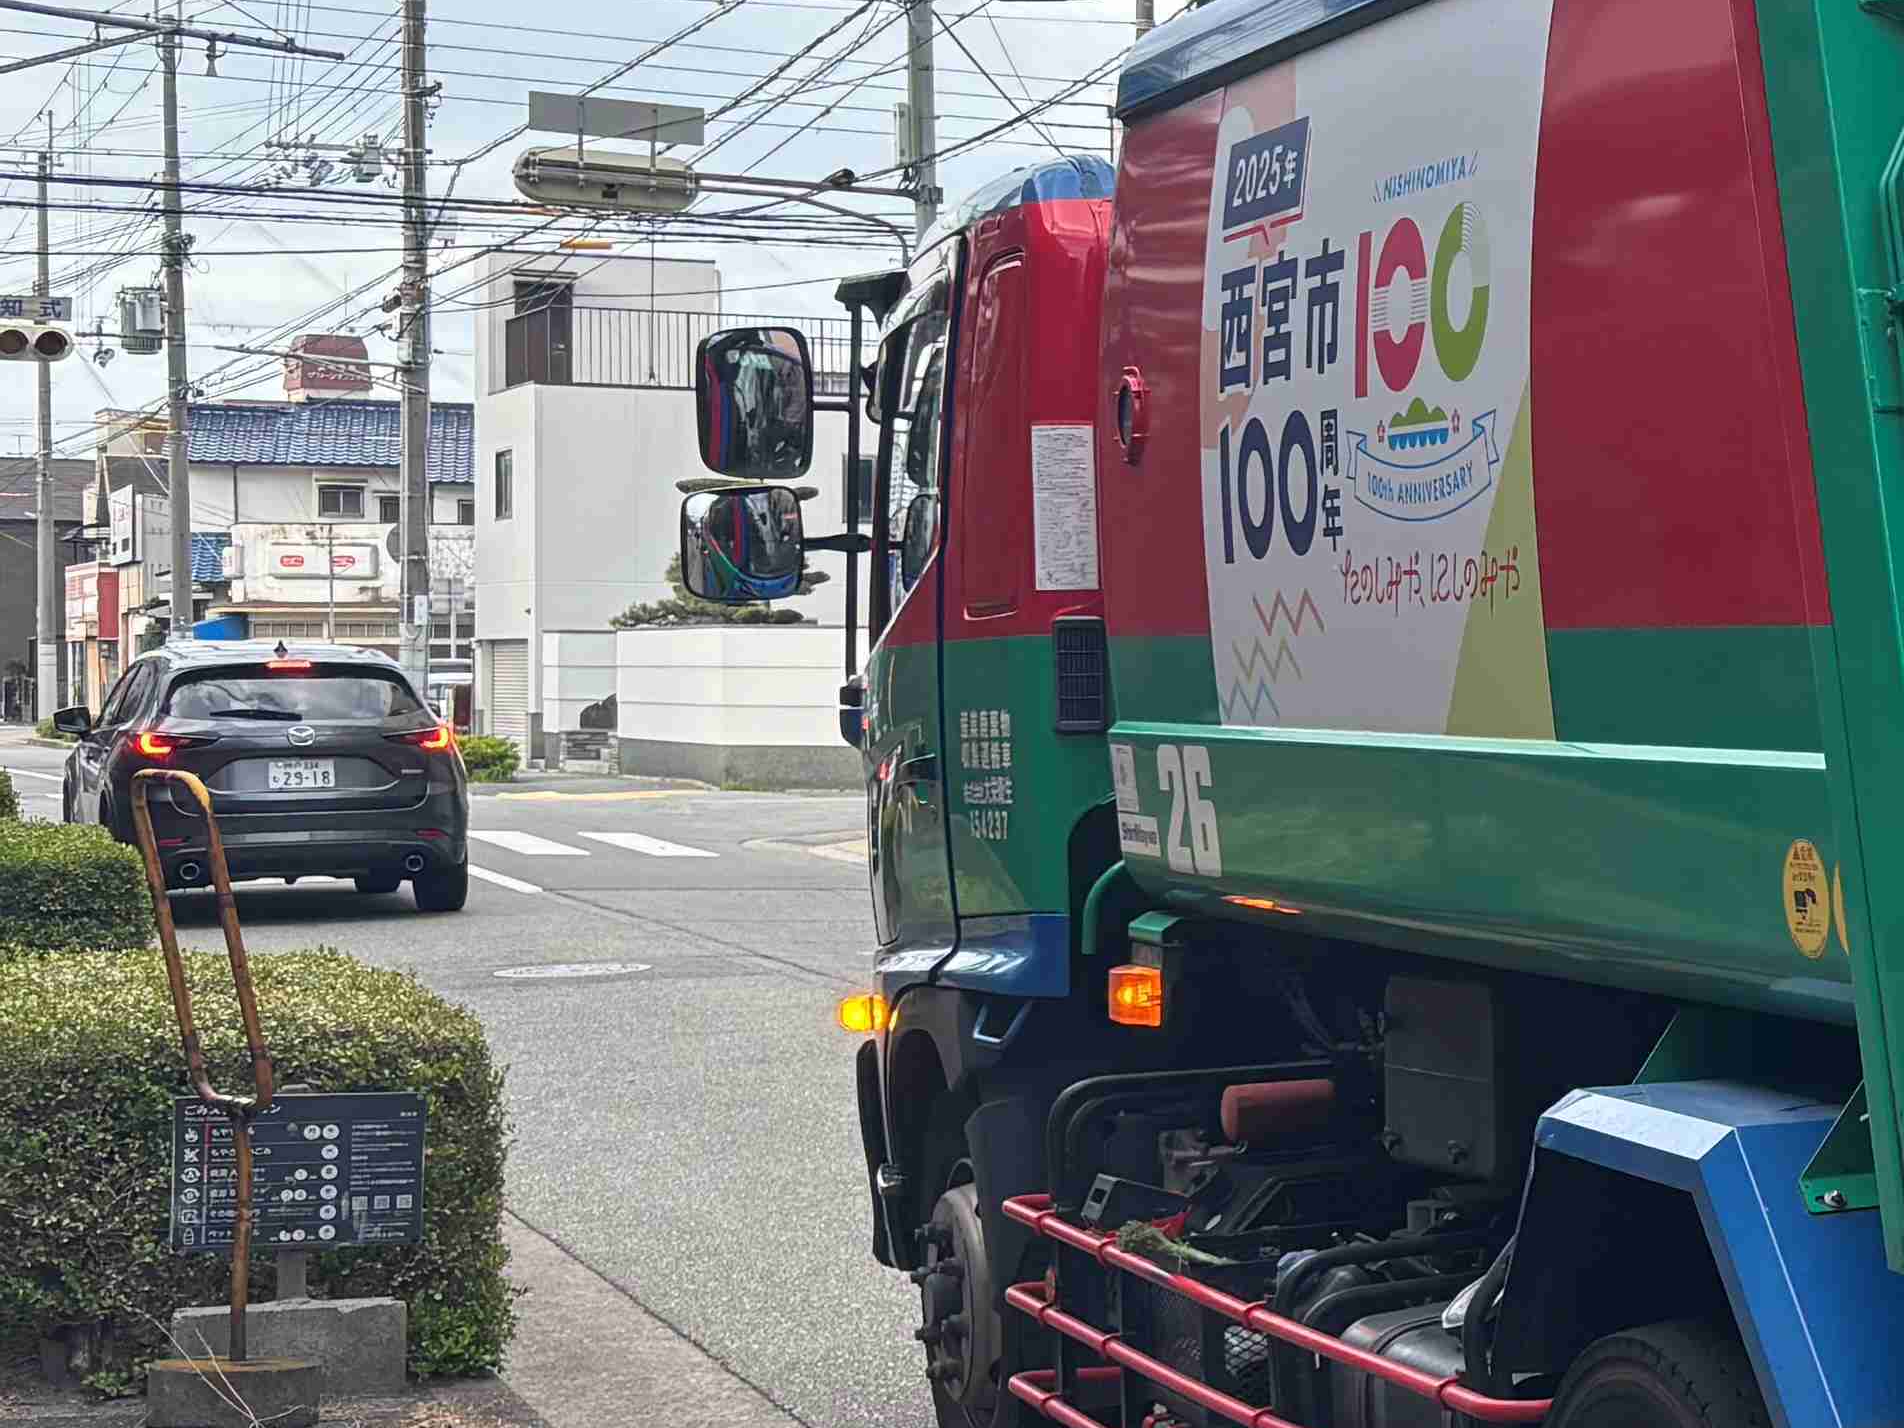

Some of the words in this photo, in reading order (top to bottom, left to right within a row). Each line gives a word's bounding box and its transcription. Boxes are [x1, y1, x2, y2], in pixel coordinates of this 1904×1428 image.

[1232, 144, 1298, 208] 2025年
[1382, 155, 1466, 202] NISHINOMIYA
[1219, 237, 1345, 395] 西宮市
[1367, 470, 1394, 502] 100th
[1397, 461, 1474, 504] ANNIVERSARY
[1156, 743, 1223, 878] 26
